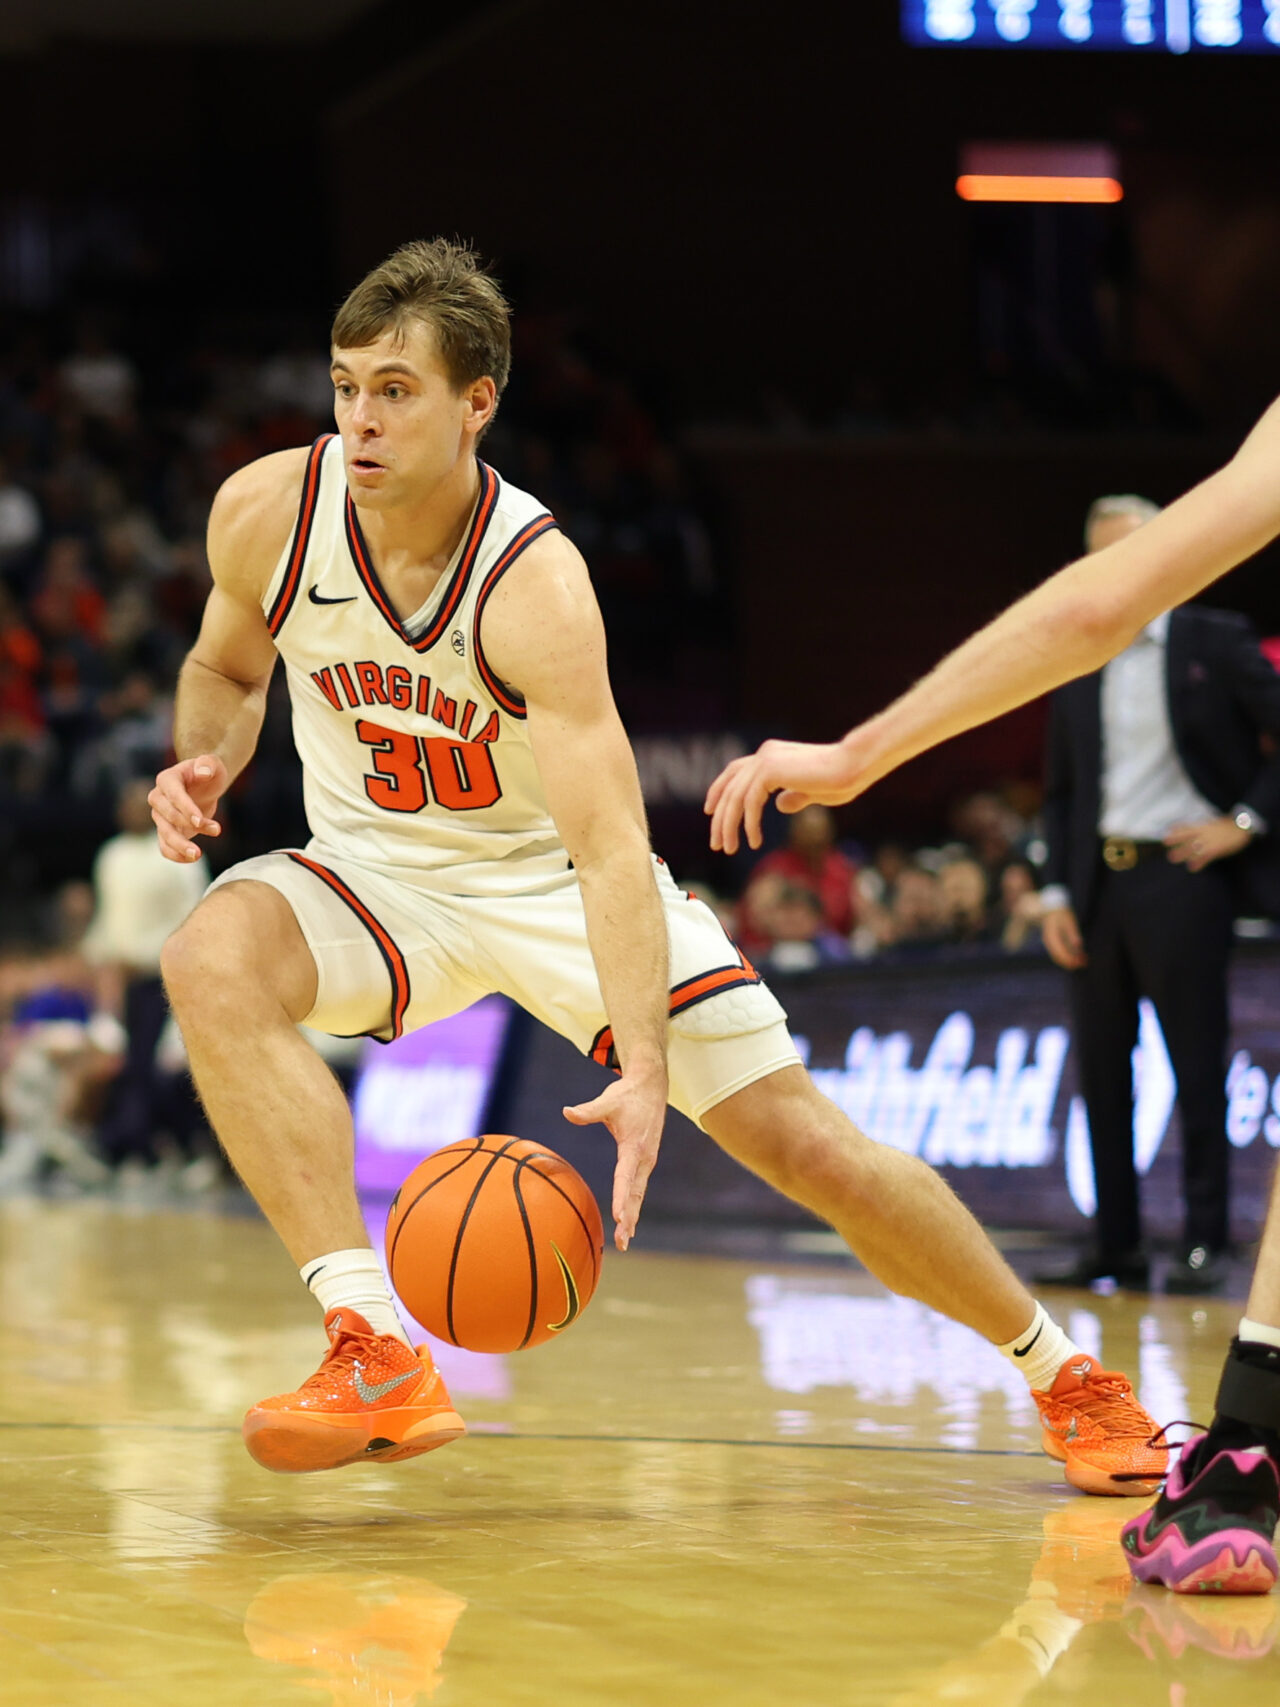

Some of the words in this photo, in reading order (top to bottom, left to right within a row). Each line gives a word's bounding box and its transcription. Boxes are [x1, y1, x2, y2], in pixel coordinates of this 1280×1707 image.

[310, 661, 499, 743] VIRGINIA
[355, 719, 502, 813] 30
[796, 1012, 1068, 1166] ithfield
